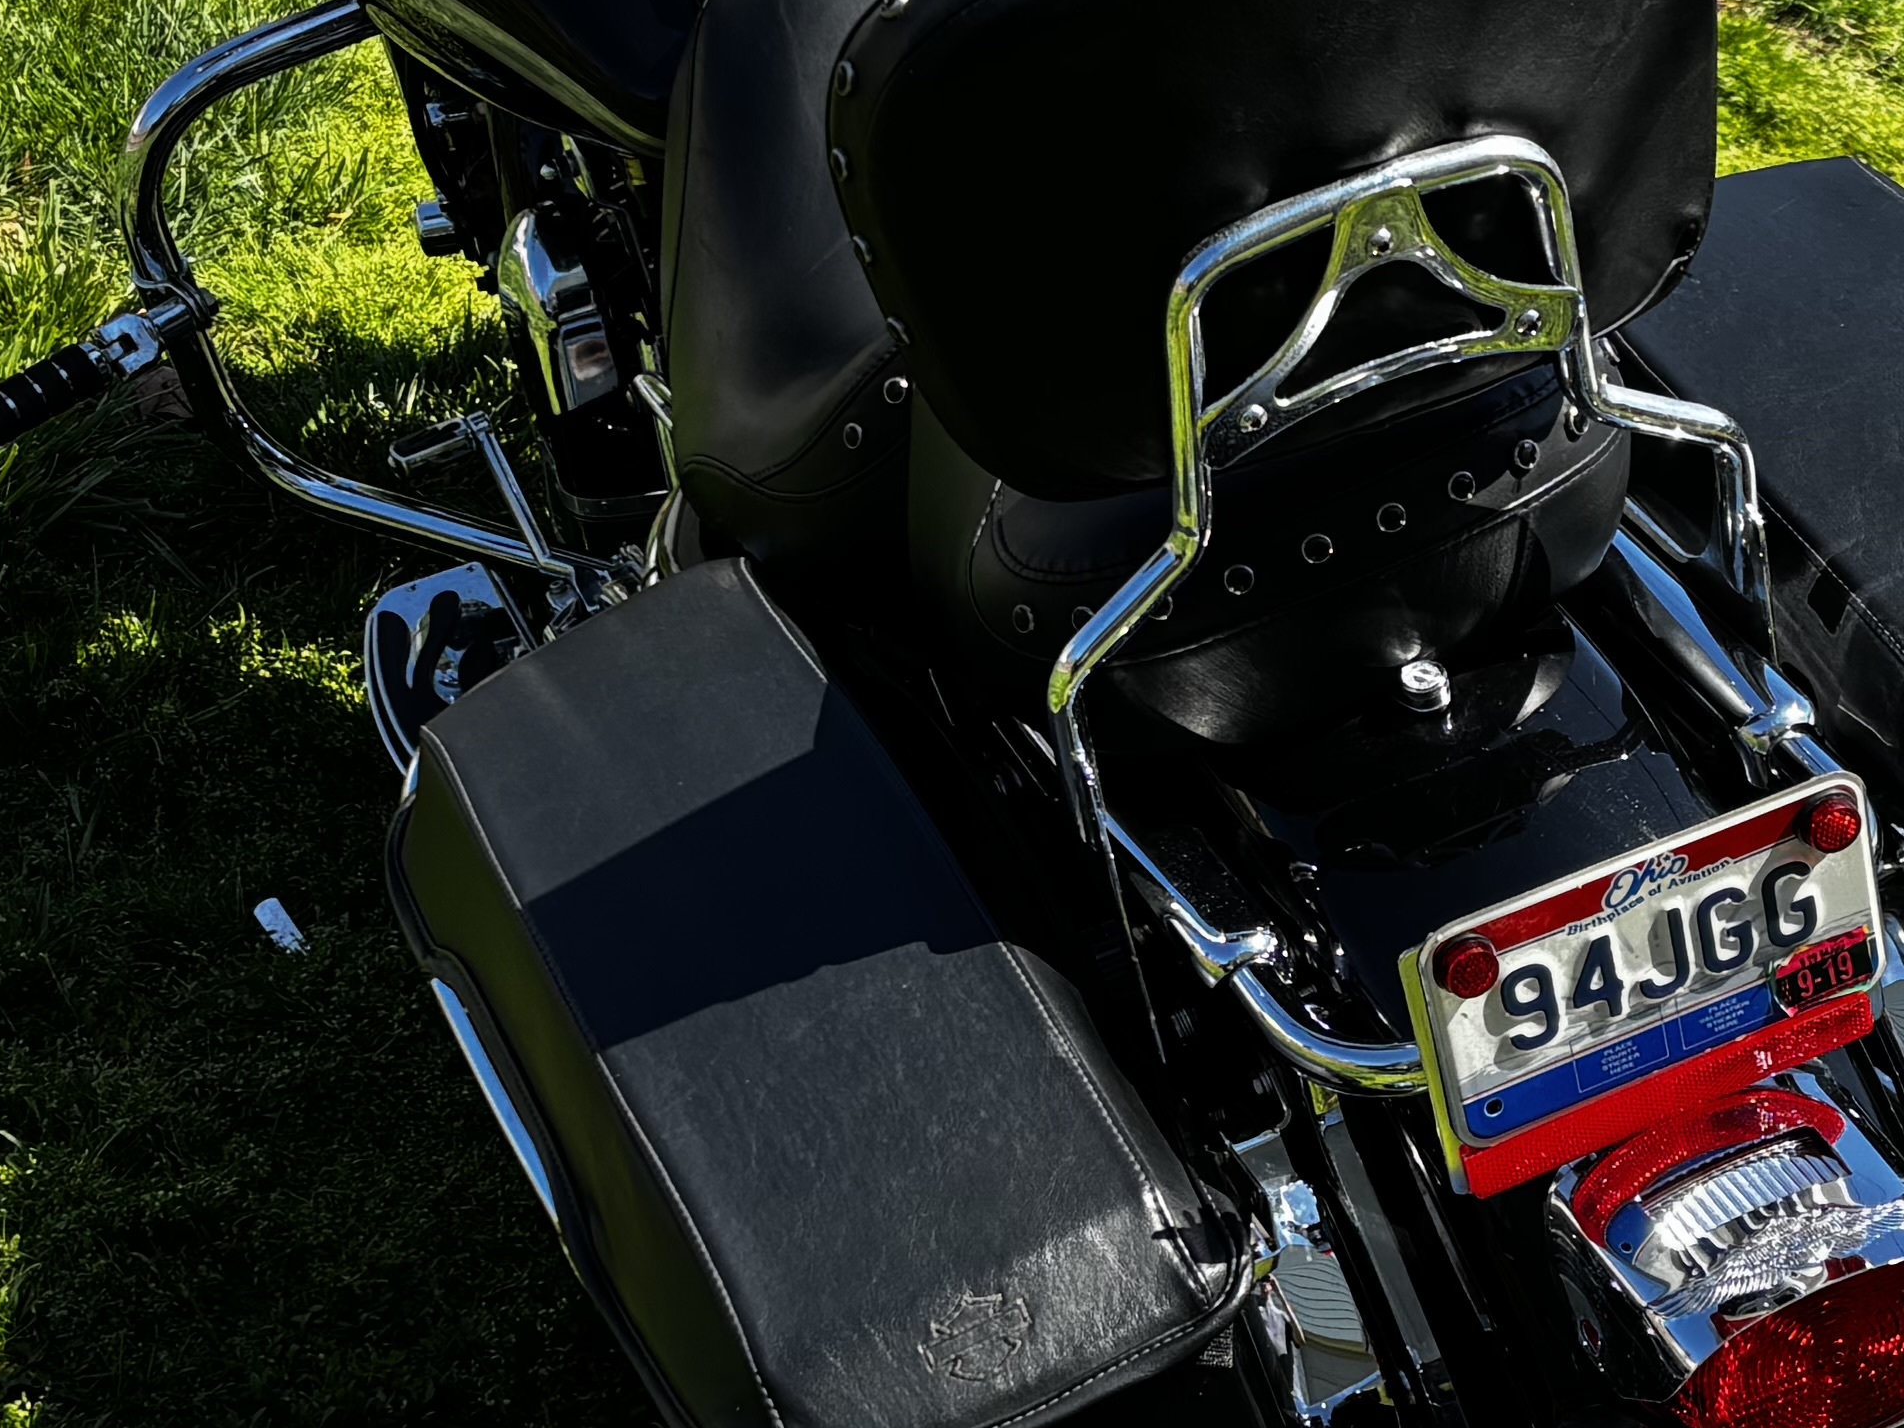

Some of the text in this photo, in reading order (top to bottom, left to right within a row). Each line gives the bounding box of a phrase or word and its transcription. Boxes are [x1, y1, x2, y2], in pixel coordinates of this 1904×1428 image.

[1567, 858, 1731, 936] Birthplace of Aviation
[1604, 854, 1688, 909] Ohio
[1499, 860, 1818, 1051] 94JGG
[1797, 951, 1854, 998] 9-19
